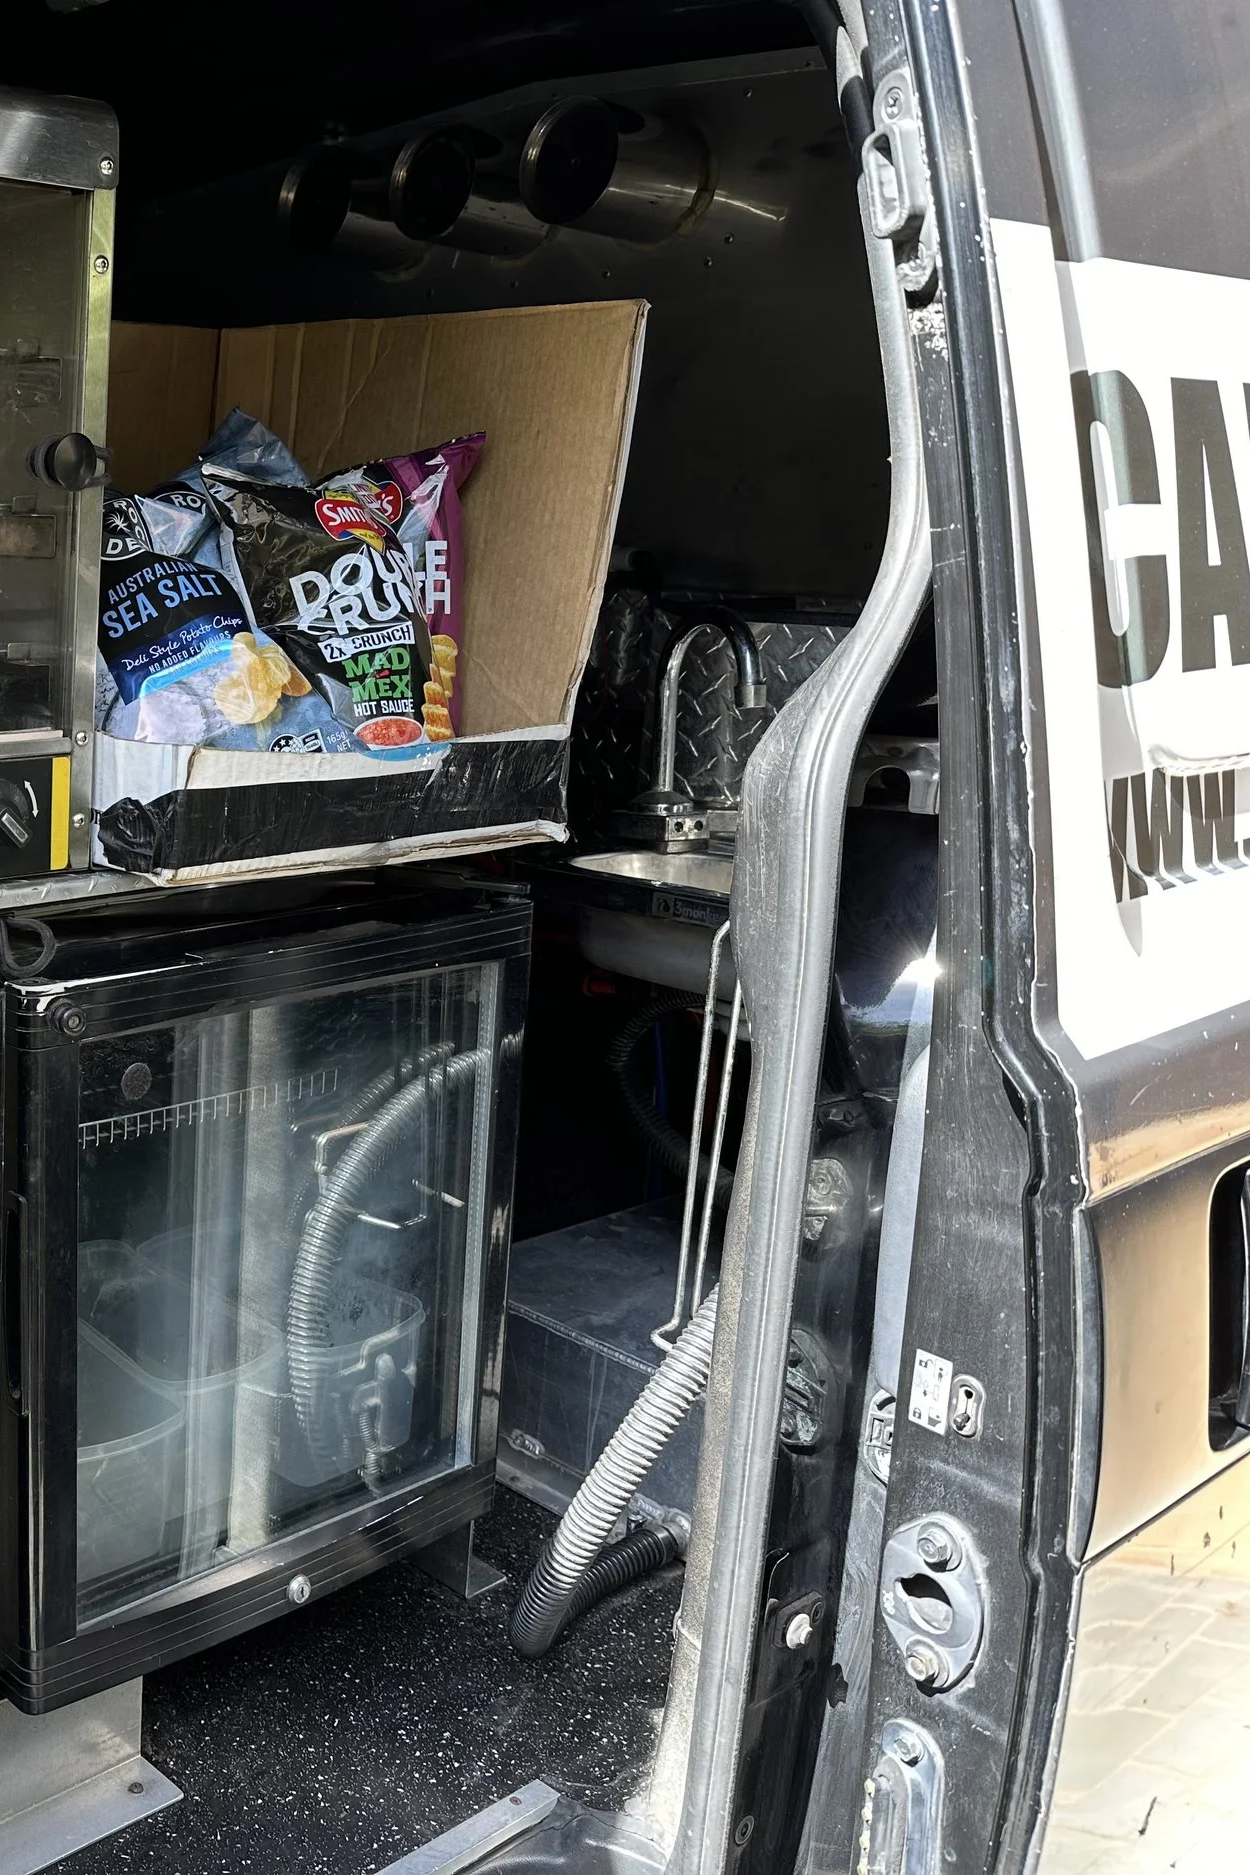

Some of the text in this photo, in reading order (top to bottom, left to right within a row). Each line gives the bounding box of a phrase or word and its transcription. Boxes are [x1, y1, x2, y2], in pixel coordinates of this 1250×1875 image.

[112, 500, 146, 542] ROC
[322, 503, 379, 530] SMIT
[1070, 368, 1250, 688] CA
[106, 538, 142, 555] DE
[107, 561, 198, 604] AUSTRALIAN
[288, 544, 418, 617] DOUB
[102, 574, 222, 638] SEA SALT
[297, 579, 418, 636] CRUN
[121, 654, 150, 671] Deli
[149, 640, 181, 659] Style
[179, 623, 212, 645] Potato
[212, 615, 243, 629] Chips
[148, 662, 161, 674] NO
[162, 650, 189, 668] ADDED
[190, 631, 232, 656] FLAVOURS
[352, 625, 411, 650] CRUNCH
[342, 647, 410, 678] MAD
[348, 674, 413, 702] MEX
[353, 699, 415, 717] HOT SAUCE
[336, 738, 351, 752] NET
[674, 900, 727, 921] 3monke
